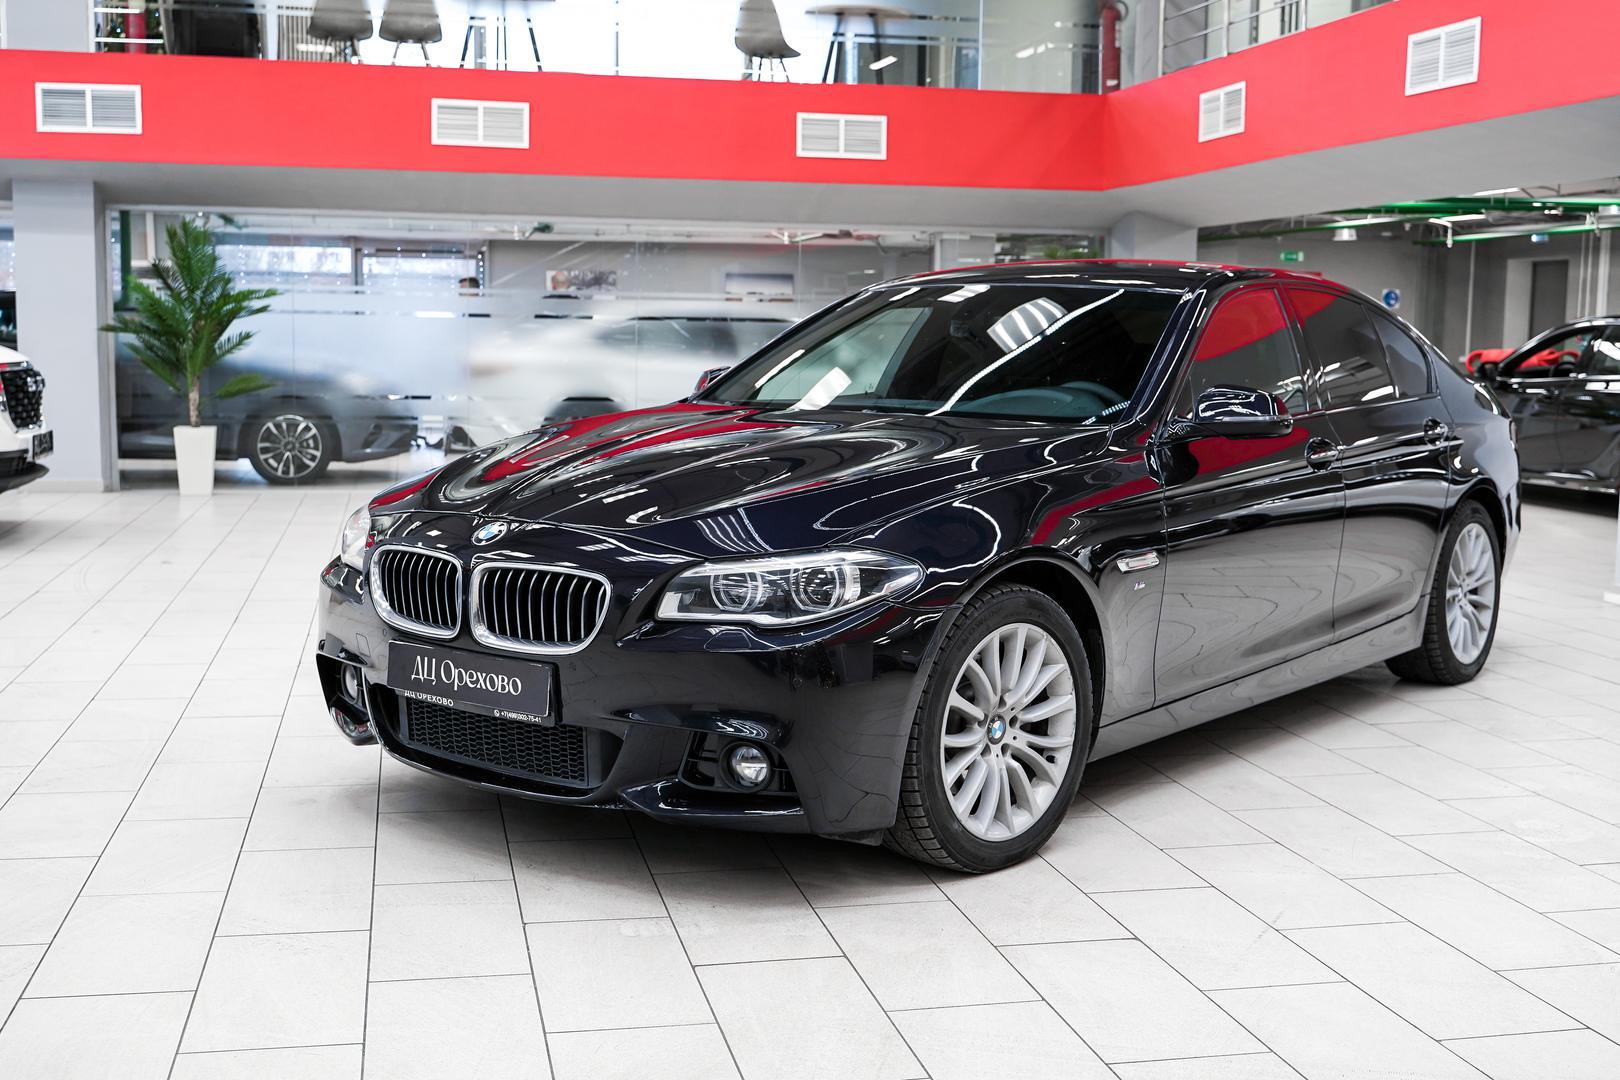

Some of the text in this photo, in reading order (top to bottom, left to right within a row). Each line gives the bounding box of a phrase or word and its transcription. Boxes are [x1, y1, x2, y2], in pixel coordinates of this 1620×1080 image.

[411, 655, 522, 695] ДЦ Орехово
[417, 692, 454, 707] ОРЕХОВО
